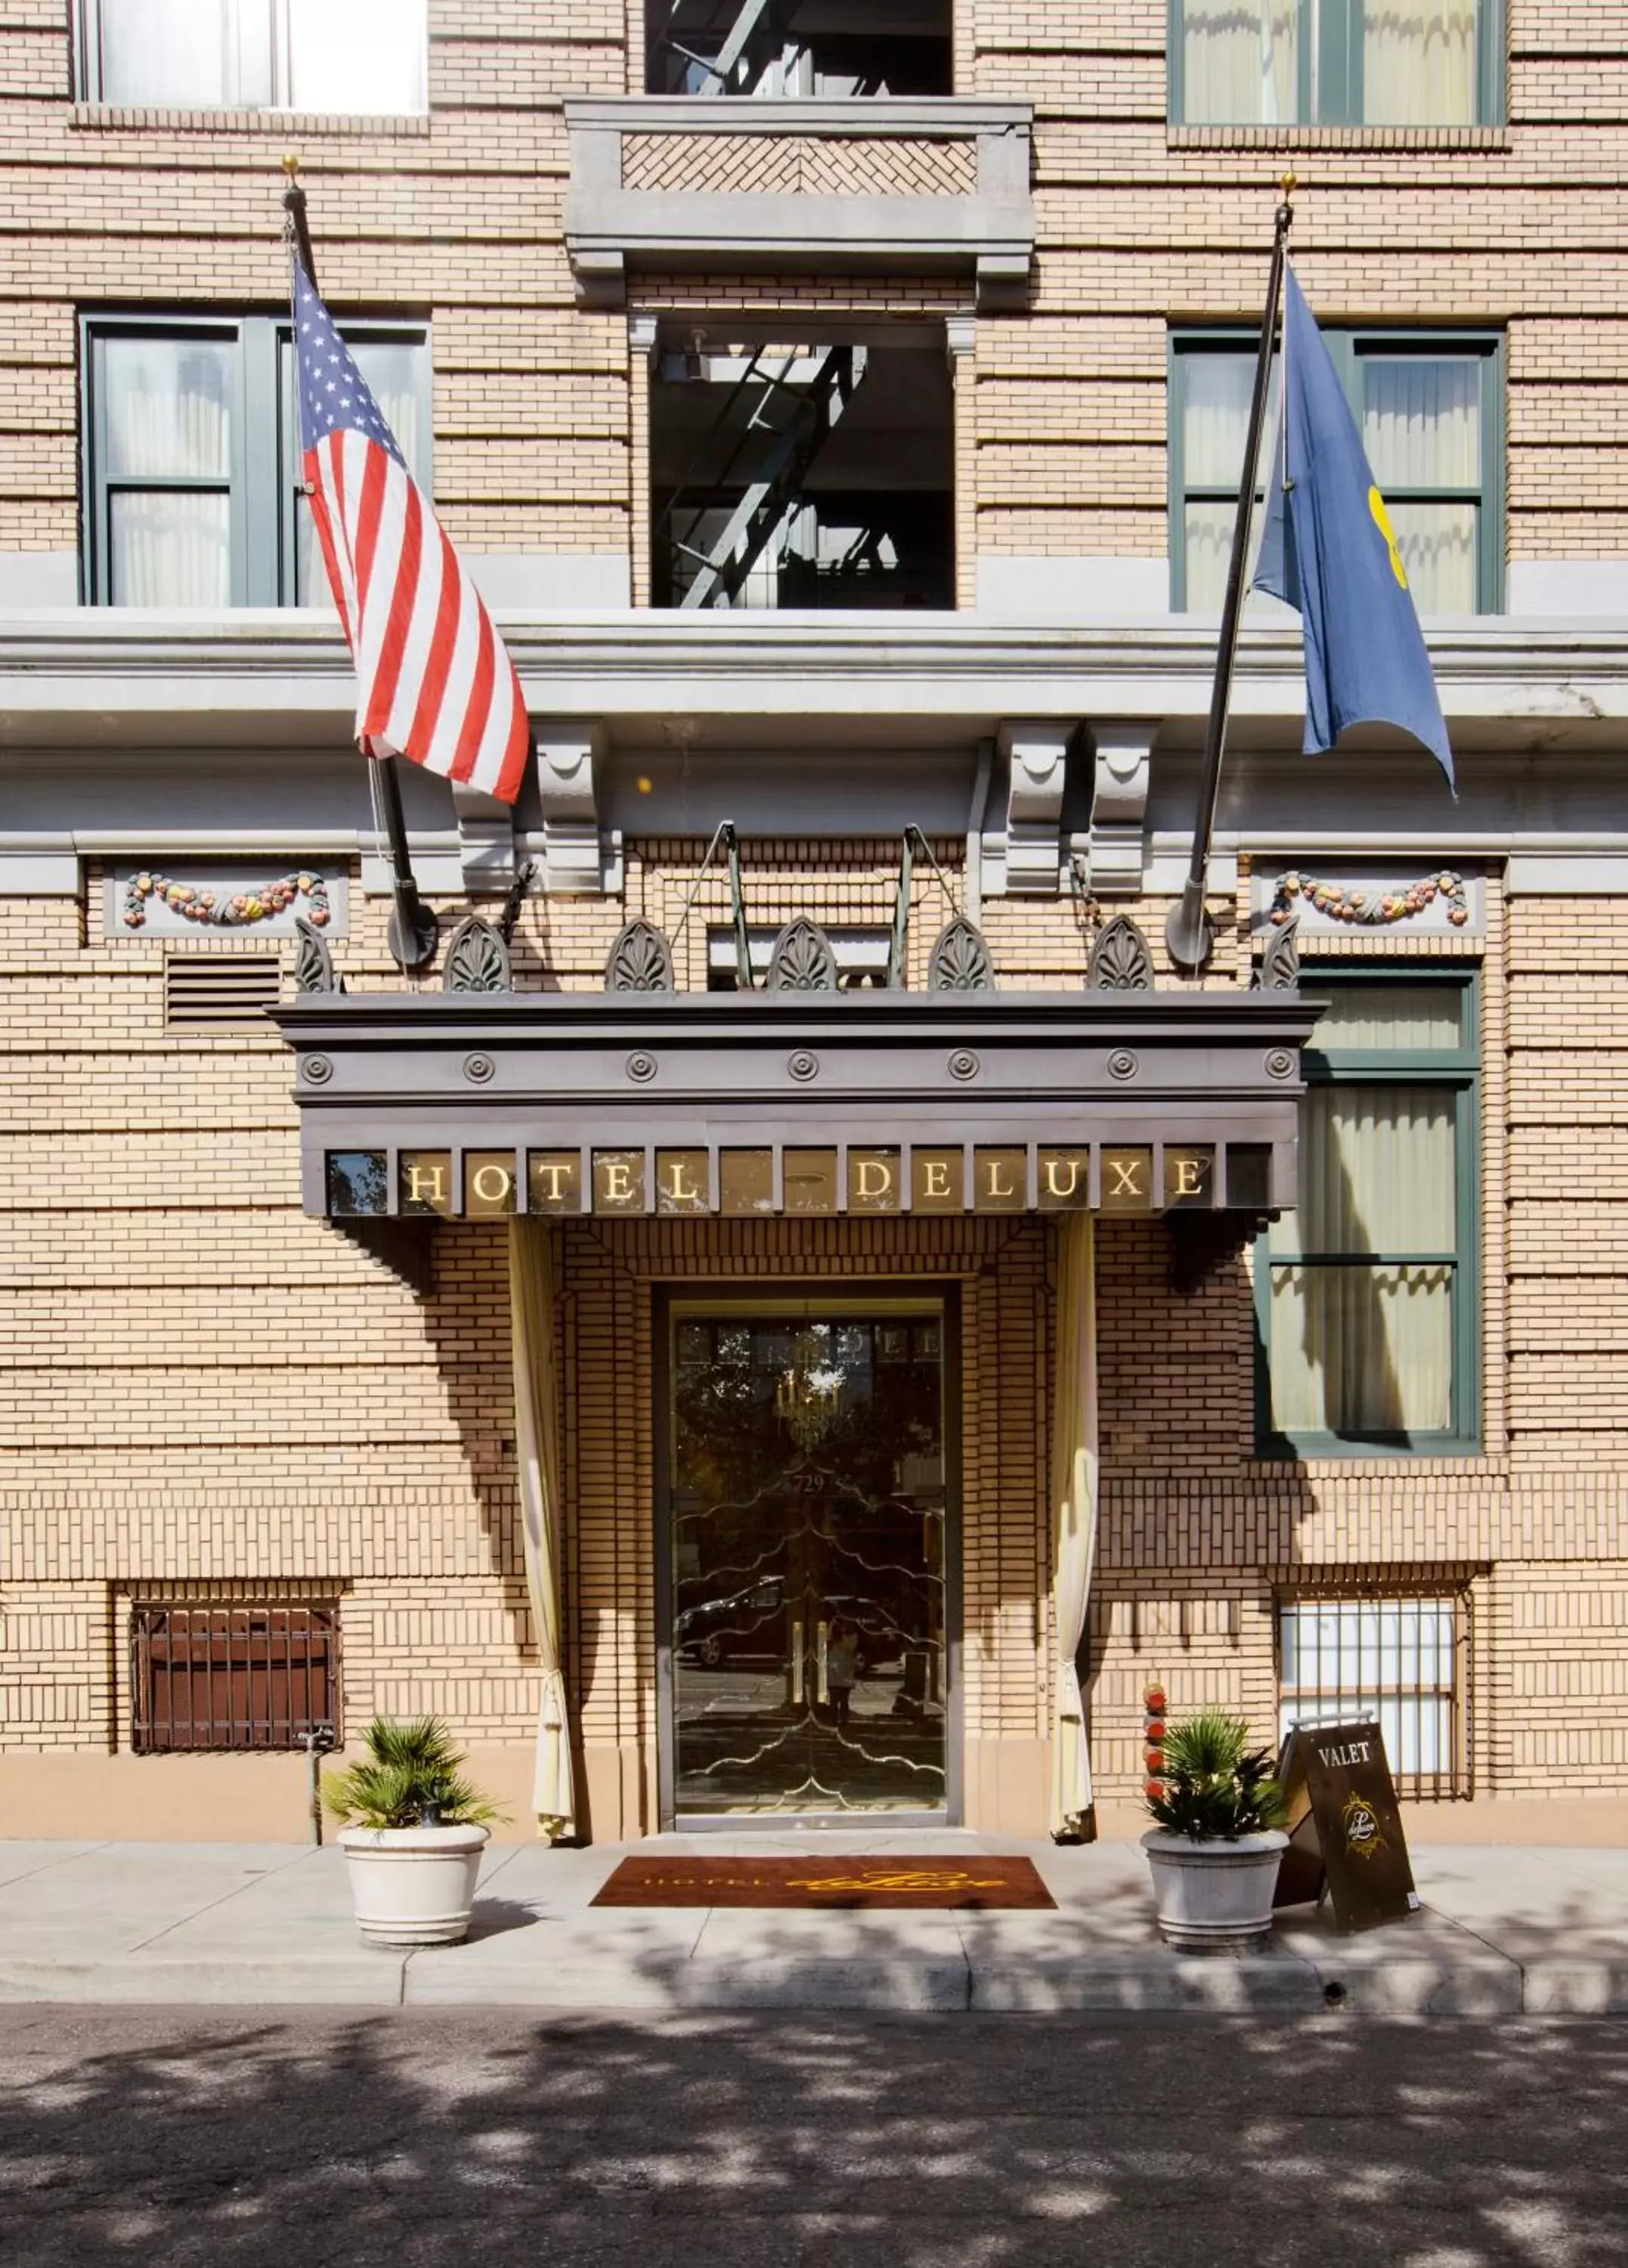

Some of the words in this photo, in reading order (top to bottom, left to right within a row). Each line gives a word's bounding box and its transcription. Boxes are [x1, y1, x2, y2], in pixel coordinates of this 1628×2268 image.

[408, 1163, 698, 1202] HOTEL
[856, 1160, 1203, 1196] DELUXE
[793, 1474, 825, 1492] 729
[1318, 1741, 1370, 1768] VALET
